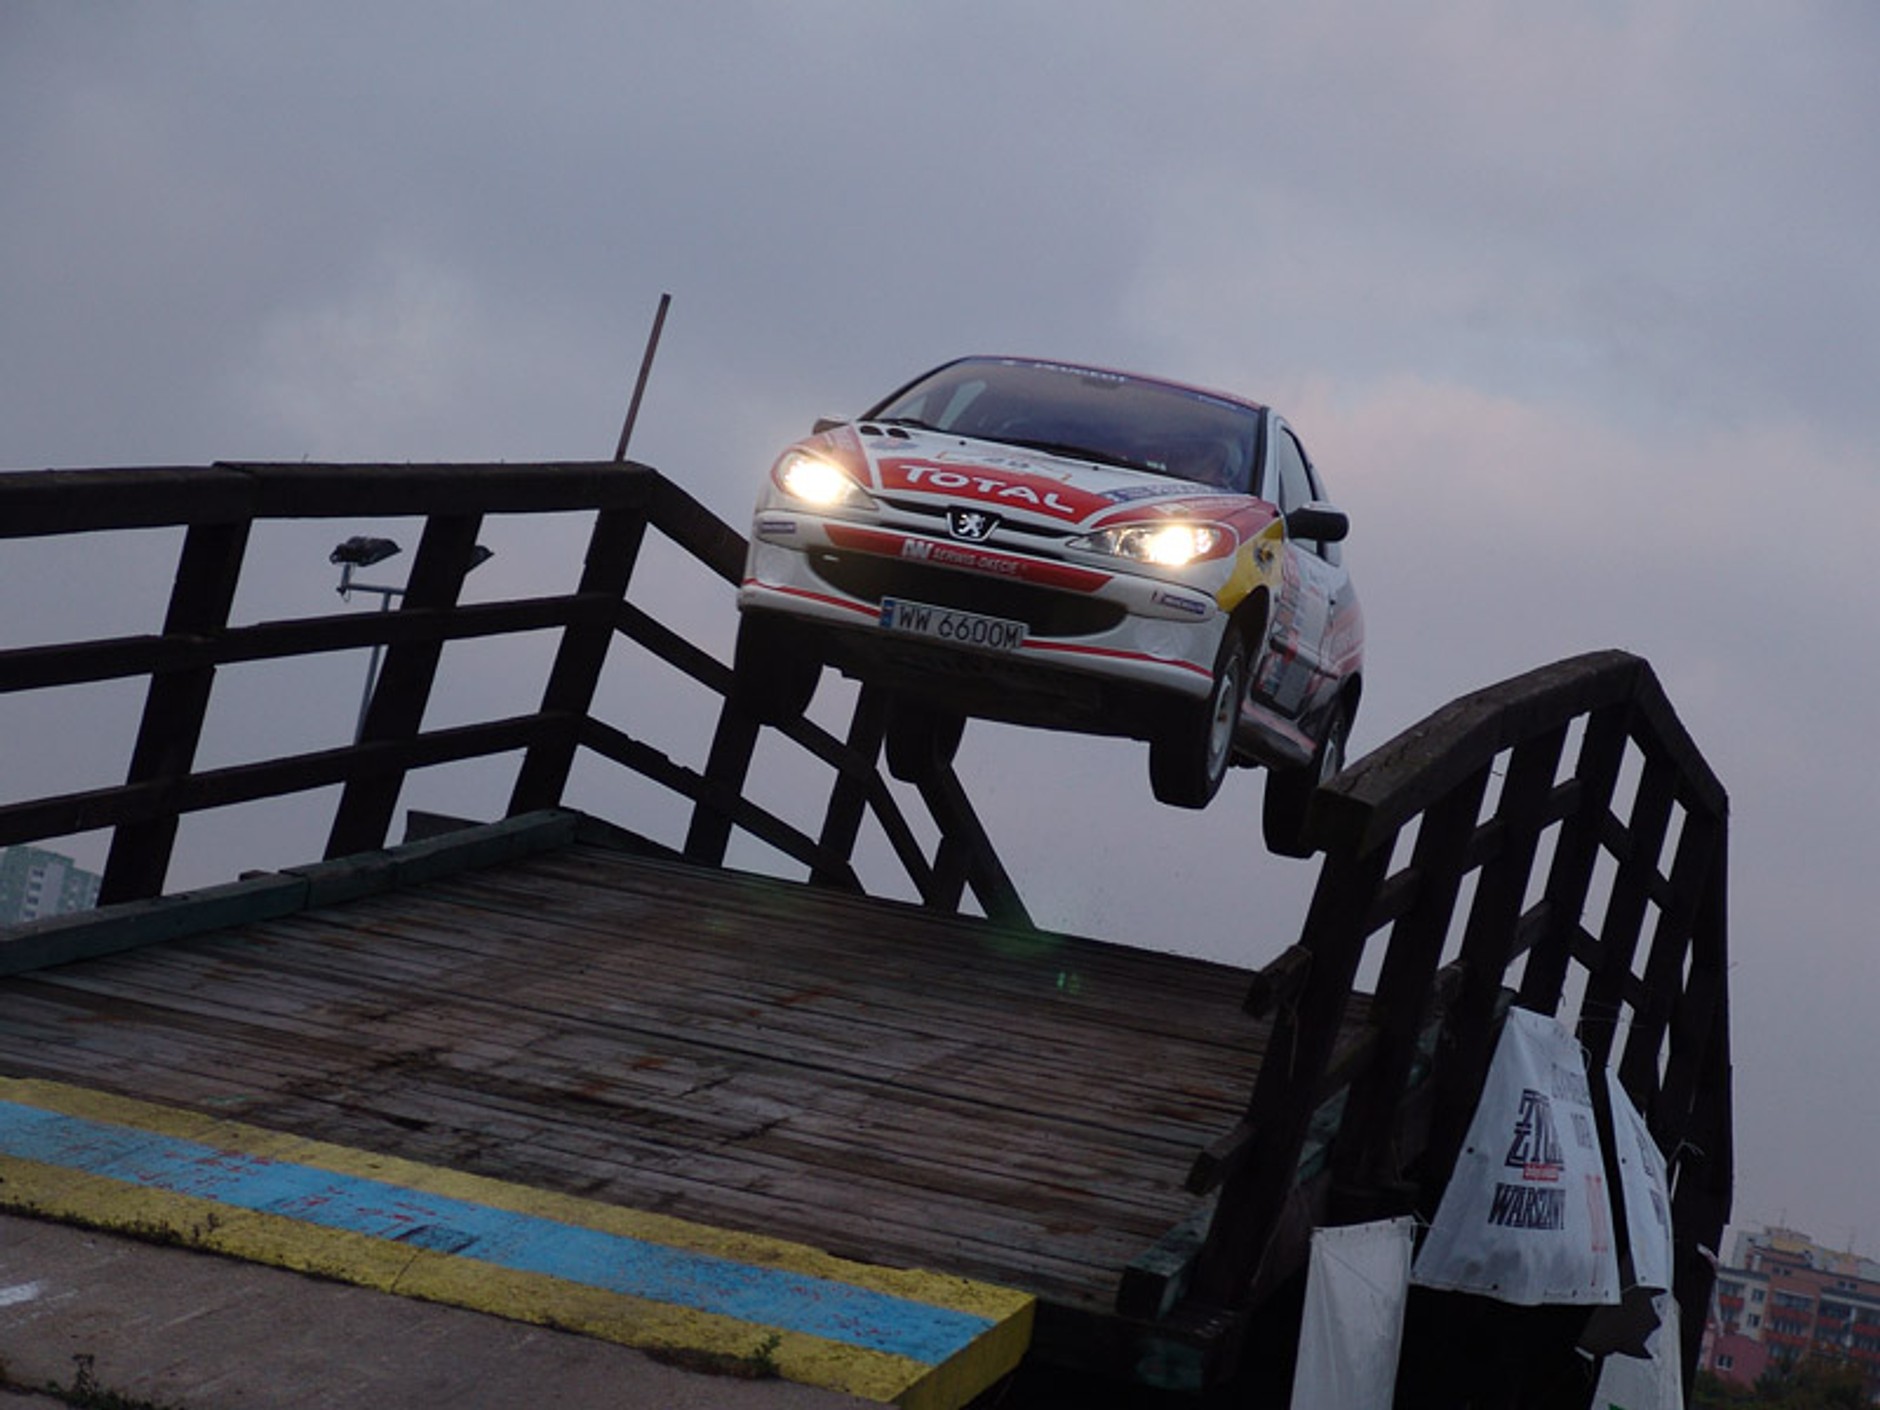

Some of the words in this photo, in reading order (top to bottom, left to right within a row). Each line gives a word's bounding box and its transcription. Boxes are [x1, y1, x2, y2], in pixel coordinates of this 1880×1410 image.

[899, 465, 1074, 513] TOTAL
[899, 605, 932, 632] WW
[937, 613, 1024, 649] 6600M
